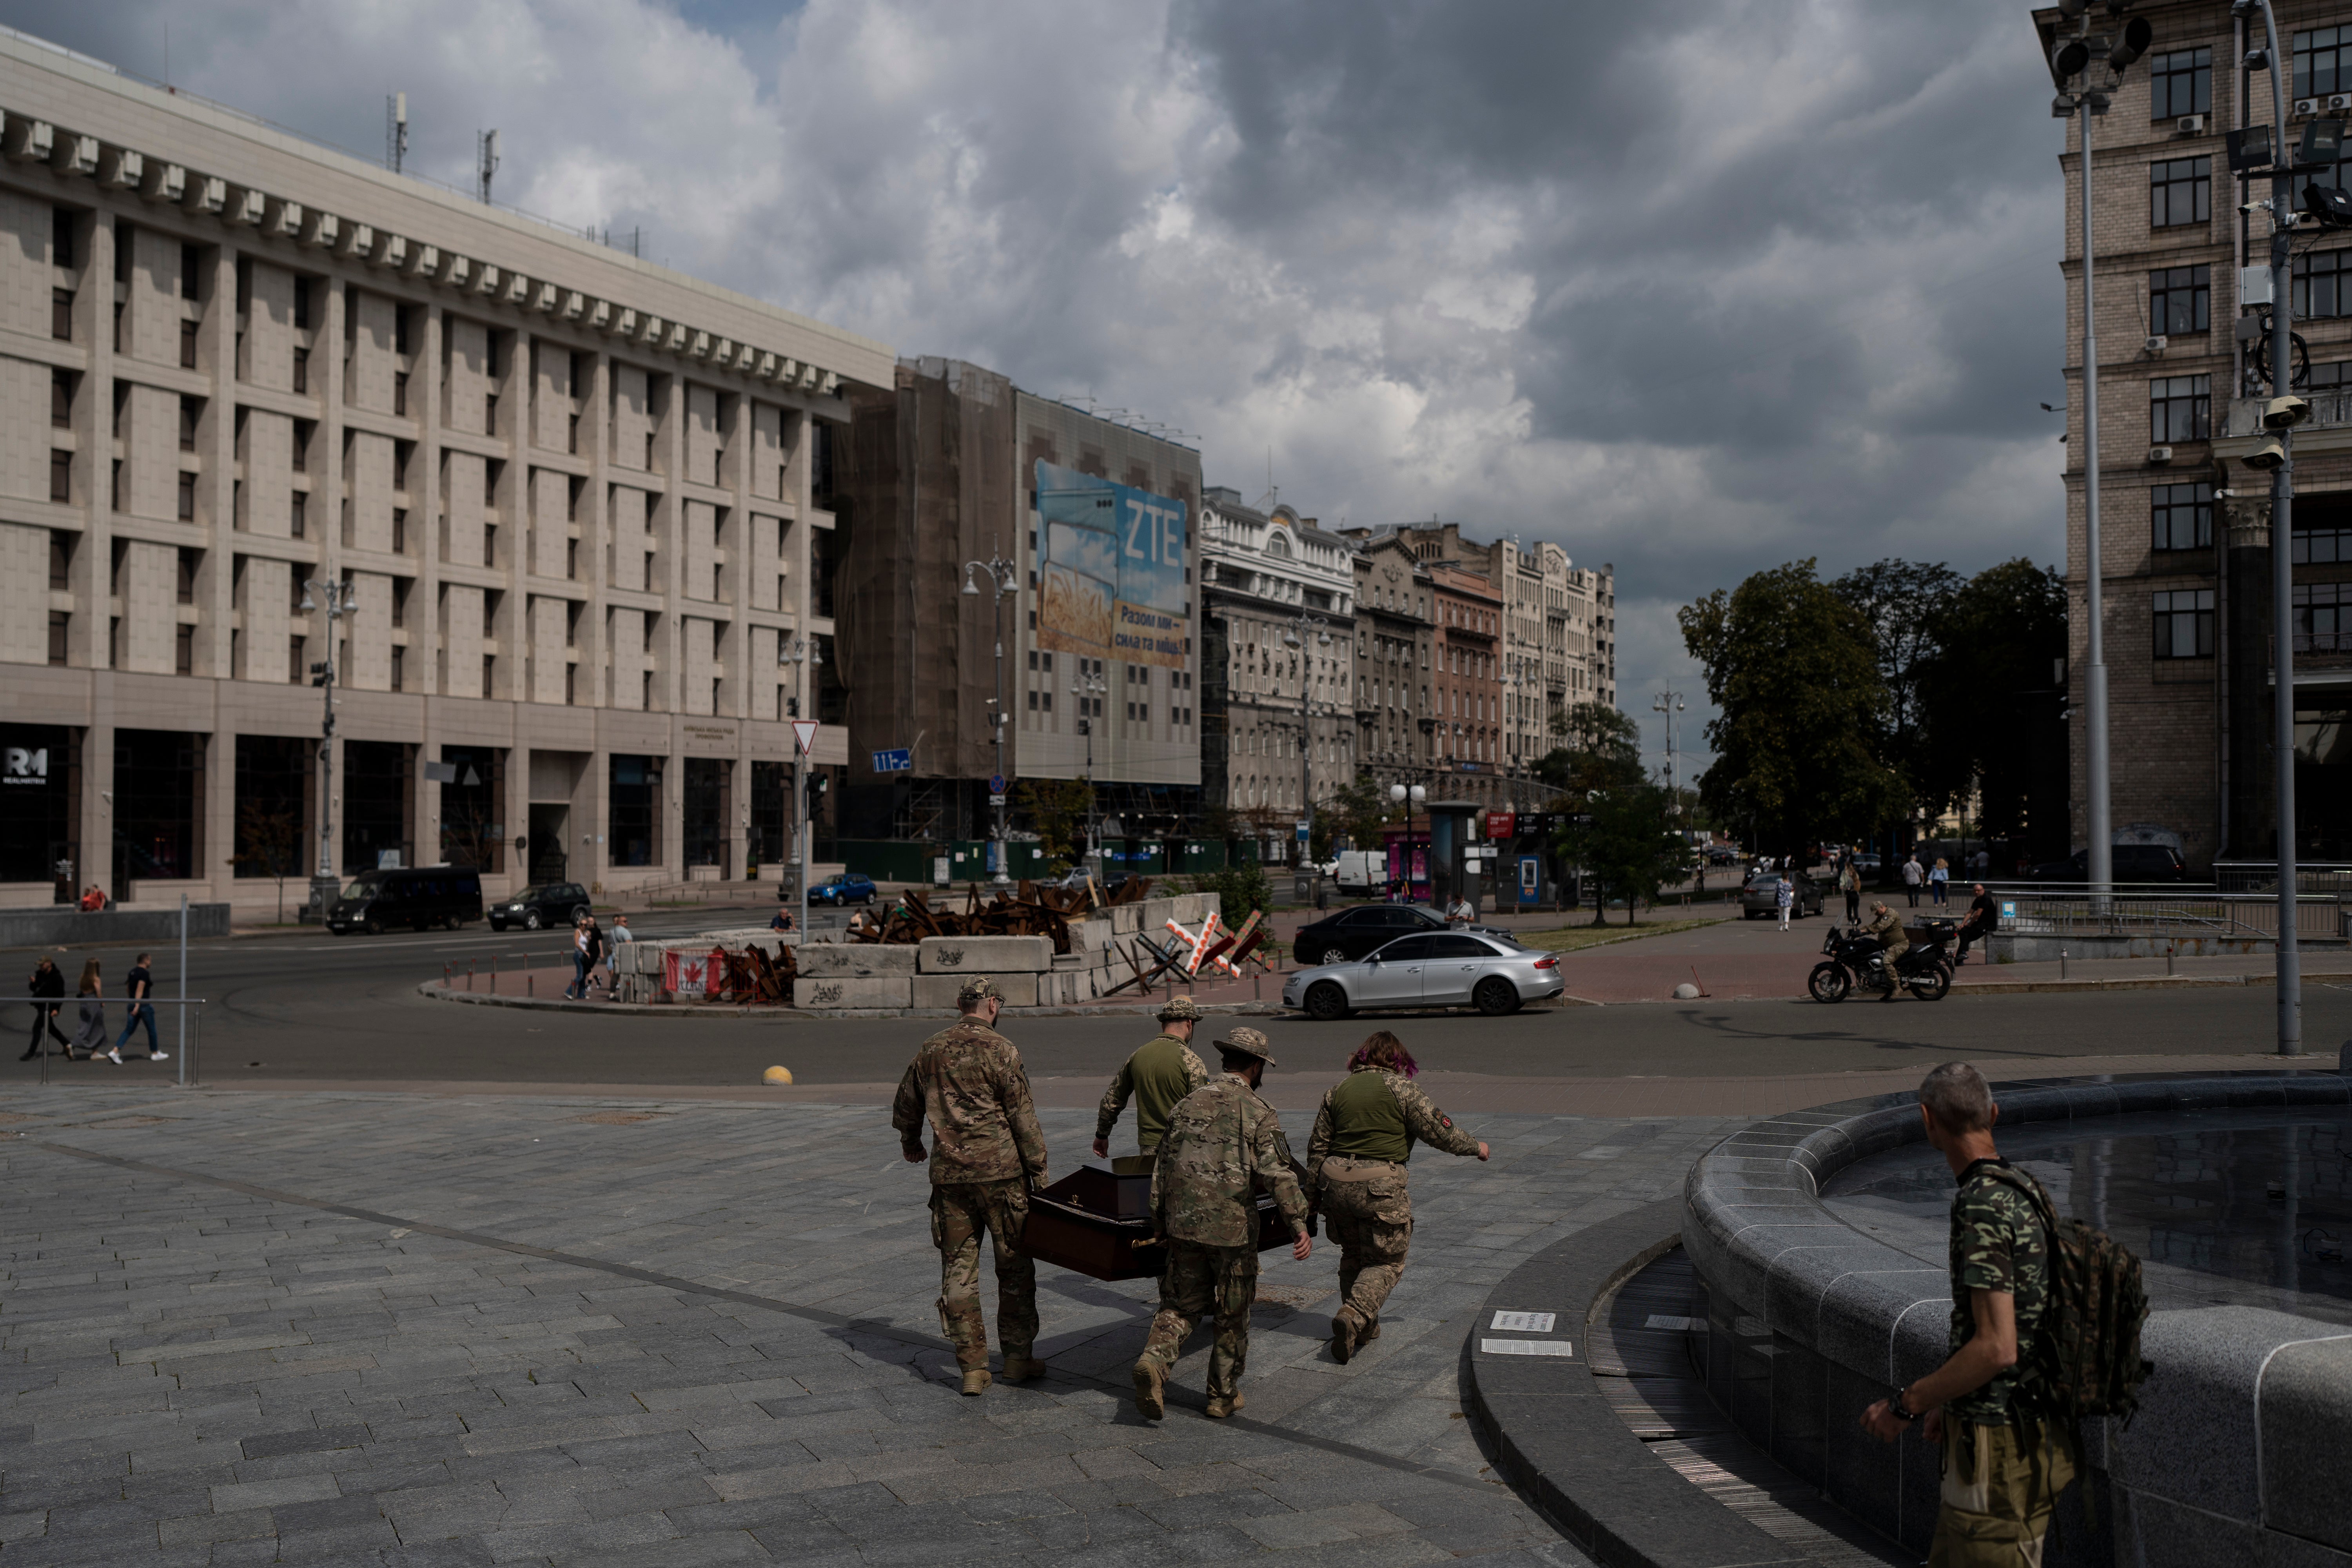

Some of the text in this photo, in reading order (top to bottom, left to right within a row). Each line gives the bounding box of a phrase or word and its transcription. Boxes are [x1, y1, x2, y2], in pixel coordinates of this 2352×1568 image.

[1125, 498, 1179, 567] ZTE
[1122, 606, 1155, 627] Разом
[1157, 616, 1172, 630] ми
[1115, 633, 1183, 656] сила та міць!
[4, 747, 48, 776] RM
[1537, 1323, 1547, 1331] country
